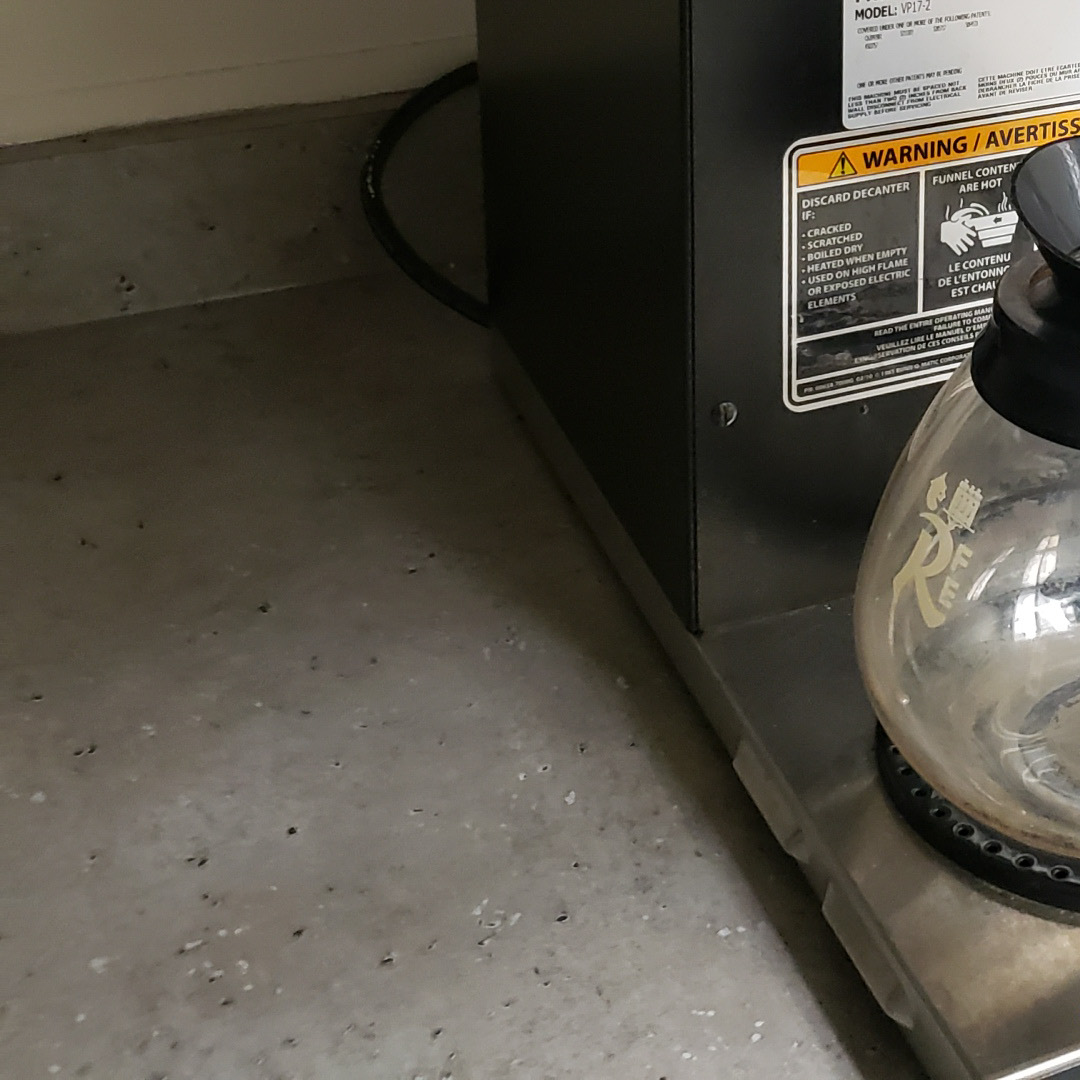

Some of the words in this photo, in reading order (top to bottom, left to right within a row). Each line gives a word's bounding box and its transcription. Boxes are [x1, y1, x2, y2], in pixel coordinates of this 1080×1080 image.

[855, 5, 898, 21] MODEL:
[862, 135, 968, 170] WARNING
[932, 170, 974, 186] FUNNEL
[959, 183, 979, 194] ARE
[981, 177, 1003, 189] HOT
[802, 192, 851, 209] DISCARD
[853, 181, 910, 200] DECANTER
[801, 210, 816, 221] IF:
[807, 223, 852, 238] CRACKED
[807, 232, 863, 250] SCRATCHED
[807, 248, 842, 262] BOILED
[844, 243, 864, 254] DRY
[807, 259, 844, 273] HEATED
[845, 253, 875, 266] WHEN
[876, 246, 908, 260] EMPTY
[949, 263, 961, 273] LE
[962, 252, 1012, 270] CONTENU
[808, 272, 834, 285] USED
[835, 269, 850, 279] ON
[851, 264, 876, 276] HIGH
[877, 258, 909, 271] FLAME
[807, 286, 822, 296] OR
[823, 277, 867, 293] EXPOSED
[868, 268, 911, 285] ELECTRIC
[938, 276, 952, 288] DE
[951, 285, 970, 298] EST
[807, 292, 857, 310] ELEMENTS
[874, 327, 894, 337] READ
[934, 312, 973, 325] OPERATING
[962, 318, 971, 326] TO
[935, 327, 965, 338] MANUEL
[941, 333, 974, 345] CONSEILS
